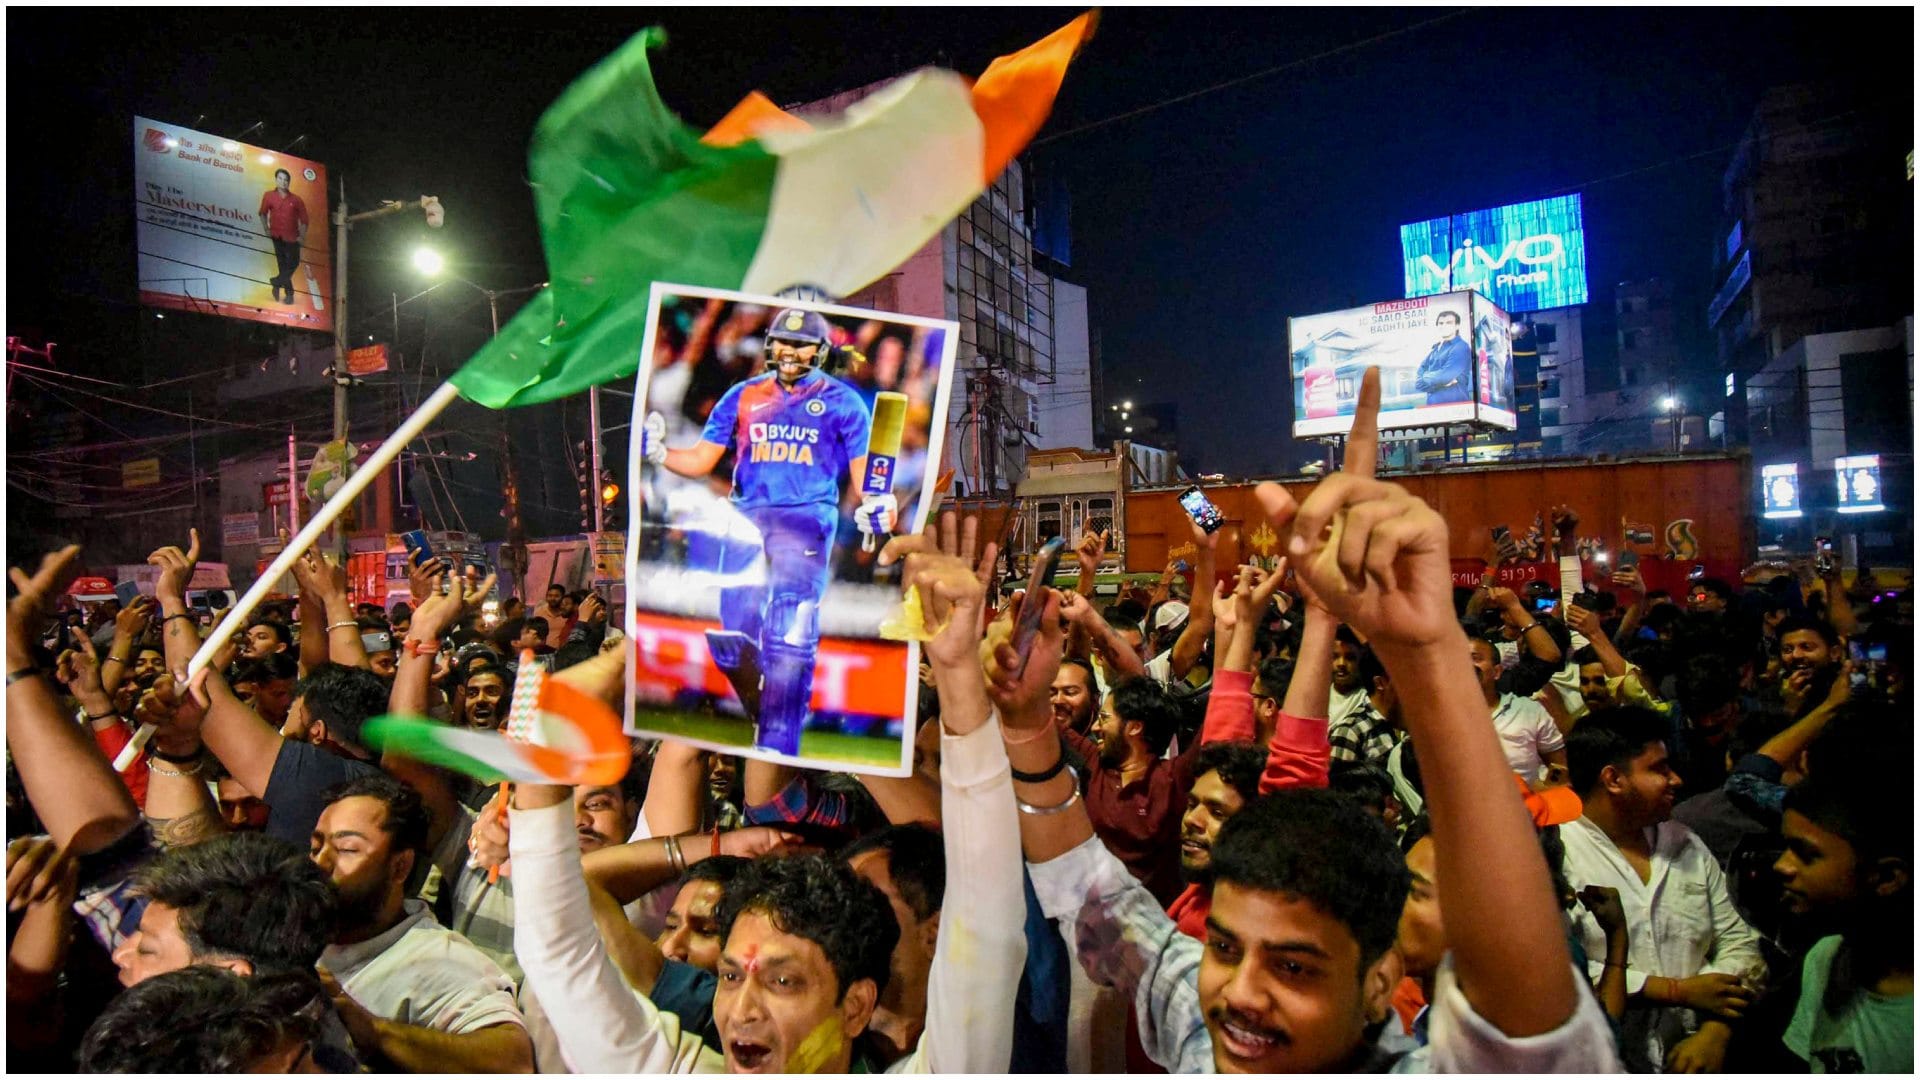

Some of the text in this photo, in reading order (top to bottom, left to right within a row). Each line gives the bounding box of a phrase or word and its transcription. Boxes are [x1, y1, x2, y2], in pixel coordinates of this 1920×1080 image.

[178, 150, 244, 173] Bank of Baroda
[146, 189, 253, 222] Masterstroke
[1420, 233, 1562, 278] vivo
[1496, 271, 1548, 288] Phone
[1377, 298, 1427, 314] MAZBOOTI
[1371, 312, 1401, 324] SAALO
[768, 423, 819, 444] BYJU'S
[750, 441, 814, 466] INDIA
[869, 457, 889, 490] CEAT
